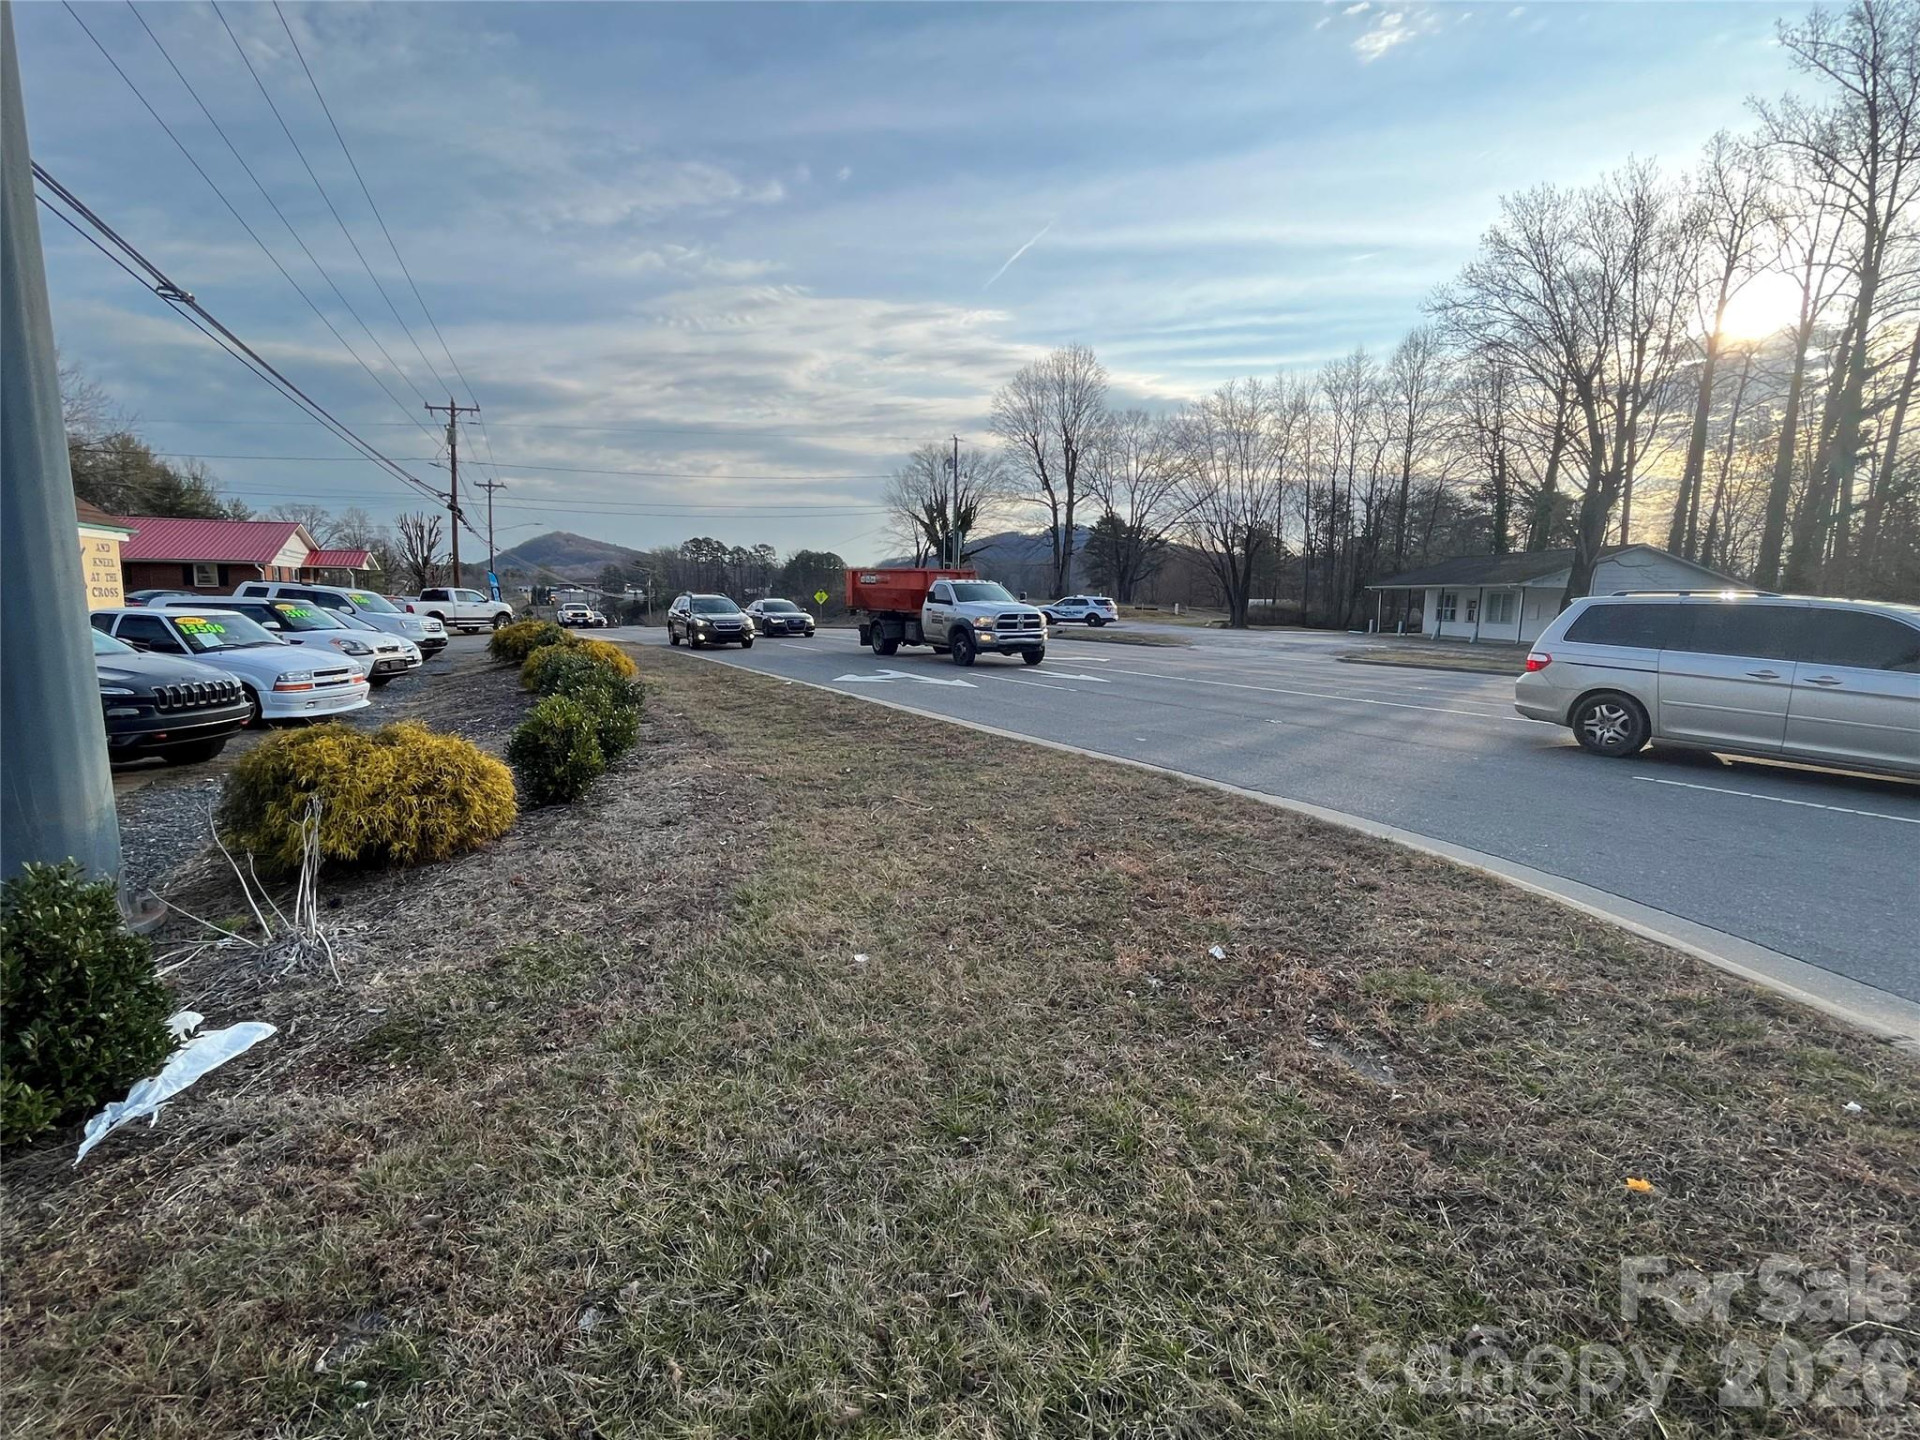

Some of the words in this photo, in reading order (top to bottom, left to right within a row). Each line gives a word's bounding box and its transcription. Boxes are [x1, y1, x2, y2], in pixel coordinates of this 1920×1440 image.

[91, 572, 100, 582] AT
[105, 573, 117, 582] THE
[92, 587, 119, 598] CROSS
